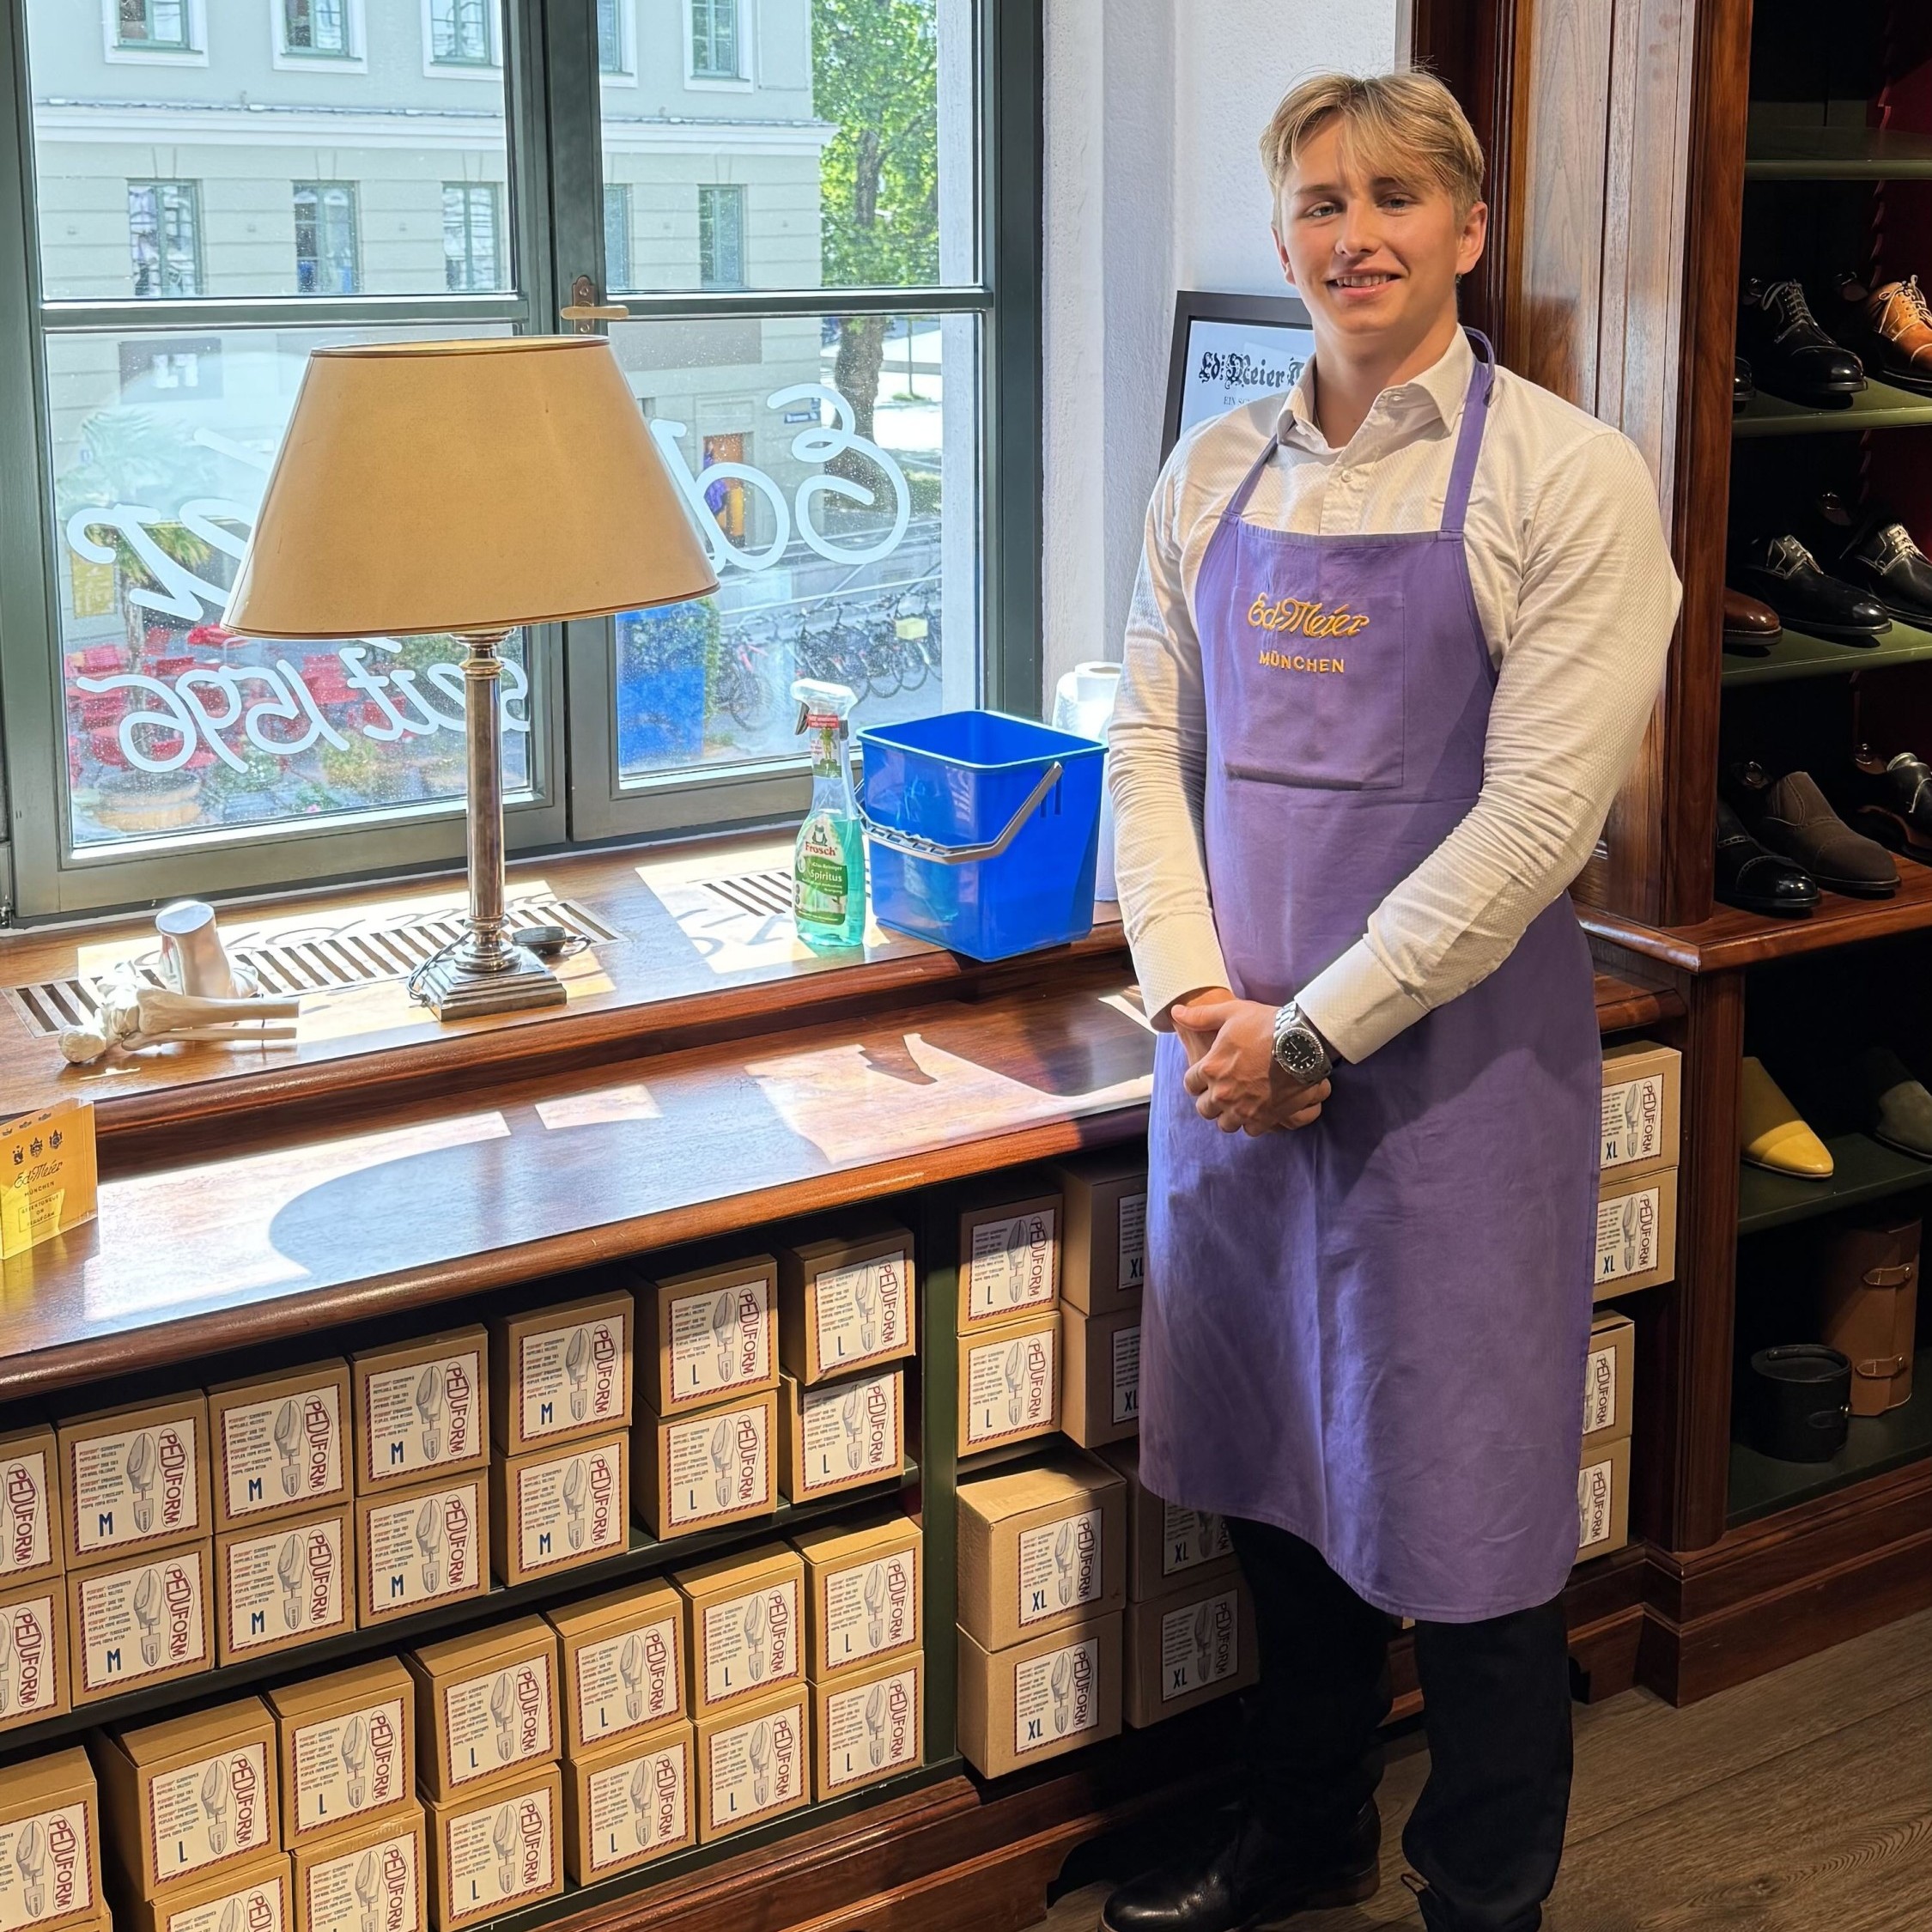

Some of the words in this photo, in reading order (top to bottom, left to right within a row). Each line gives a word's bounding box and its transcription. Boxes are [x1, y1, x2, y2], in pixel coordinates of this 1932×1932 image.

[1224, 353, 1285, 390] Meier
[1224, 396, 1236, 405] EIN
[1259, 650, 1346, 674] MÜNCHEN
[805, 841, 836, 857] Frosch
[810, 870, 843, 882] Spiritus
[1643, 1084, 1656, 1153] PEDUFORM
[1606, 1141, 1618, 1159] XL
[1030, 1219, 1047, 1297] PEDUFORM
[1640, 1198, 1654, 1266] PEDUFORM
[1603, 1256, 1615, 1273] XL
[879, 1263, 900, 1344] PEDUFORM
[987, 1285, 993, 1305] L
[739, 1292, 762, 1376] PEDUFORM
[837, 1336, 845, 1357] L
[593, 1328, 617, 1414] PEDUFORM
[692, 1364, 700, 1386] L
[1029, 1344, 1046, 1419] PEDUFORM
[1597, 1358, 1611, 1425] PEDUFORM
[447, 1366, 471, 1455] PEDUFORM
[541, 1401, 553, 1425] M
[868, 1385, 889, 1465] PEDUFORM
[986, 1409, 993, 1429] L
[306, 1400, 332, 1489] PEDUFORM
[391, 1441, 404, 1465] M
[738, 1419, 760, 1500] PEDUFORM
[823, 1454, 830, 1474] L
[160, 1434, 188, 1525] PEDUFORM
[247, 1478, 263, 1502] M
[592, 1457, 615, 1542] PEDUFORM
[690, 1490, 697, 1510] L
[1593, 1472, 1607, 1539] PEDUFORM
[9, 1467, 36, 1563] PEDUFORM
[99, 1511, 113, 1537] M
[446, 1499, 471, 1586] PEDUFORM
[539, 1531, 551, 1555] M
[1078, 1522, 1096, 1598] PEDUFORM
[1175, 1540, 1189, 1563] XL
[308, 1534, 335, 1622] PEDUFORM
[392, 1573, 404, 1598] M
[888, 1563, 908, 1640] PEDUFORM
[1032, 1590, 1048, 1613] XL
[165, 1568, 194, 1659] PEDUFORM
[251, 1610, 265, 1635] M
[769, 1595, 792, 1673] PEDUFORM
[1215, 1601, 1233, 1675] PEDUFORM
[15, 1613, 41, 1705] PEDUFORM
[106, 1647, 122, 1673] M
[845, 1634, 853, 1653] L
[646, 1633, 669, 1713] PEDUFORM
[724, 1667, 732, 1687] L
[1074, 1651, 1091, 1727] PEDUFORM
[1173, 1667, 1188, 1689] XL
[517, 1670, 541, 1752] PEDUFORM
[601, 1708, 609, 1728] L
[890, 1683, 908, 1759] PEDUFORM
[1028, 1719, 1044, 1741] XL
[372, 1714, 397, 1799] PEDUFORM
[470, 1748, 478, 1769] L
[774, 1719, 795, 1797] PEDUFORM
[846, 1753, 854, 1772] L
[232, 1758, 258, 1845] PEDUFORM
[319, 1794, 328, 1815] L
[655, 1758, 678, 1838] PEDUFORM
[730, 1792, 738, 1813] L
[49, 1820, 76, 1908] PEDUFORM
[179, 1841, 188, 1863] L
[519, 1802, 544, 1885] PEDUFORM
[611, 1832, 618, 1854] L
[384, 1847, 410, 1931] PEDUFORM
[471, 1880, 480, 1901] L
